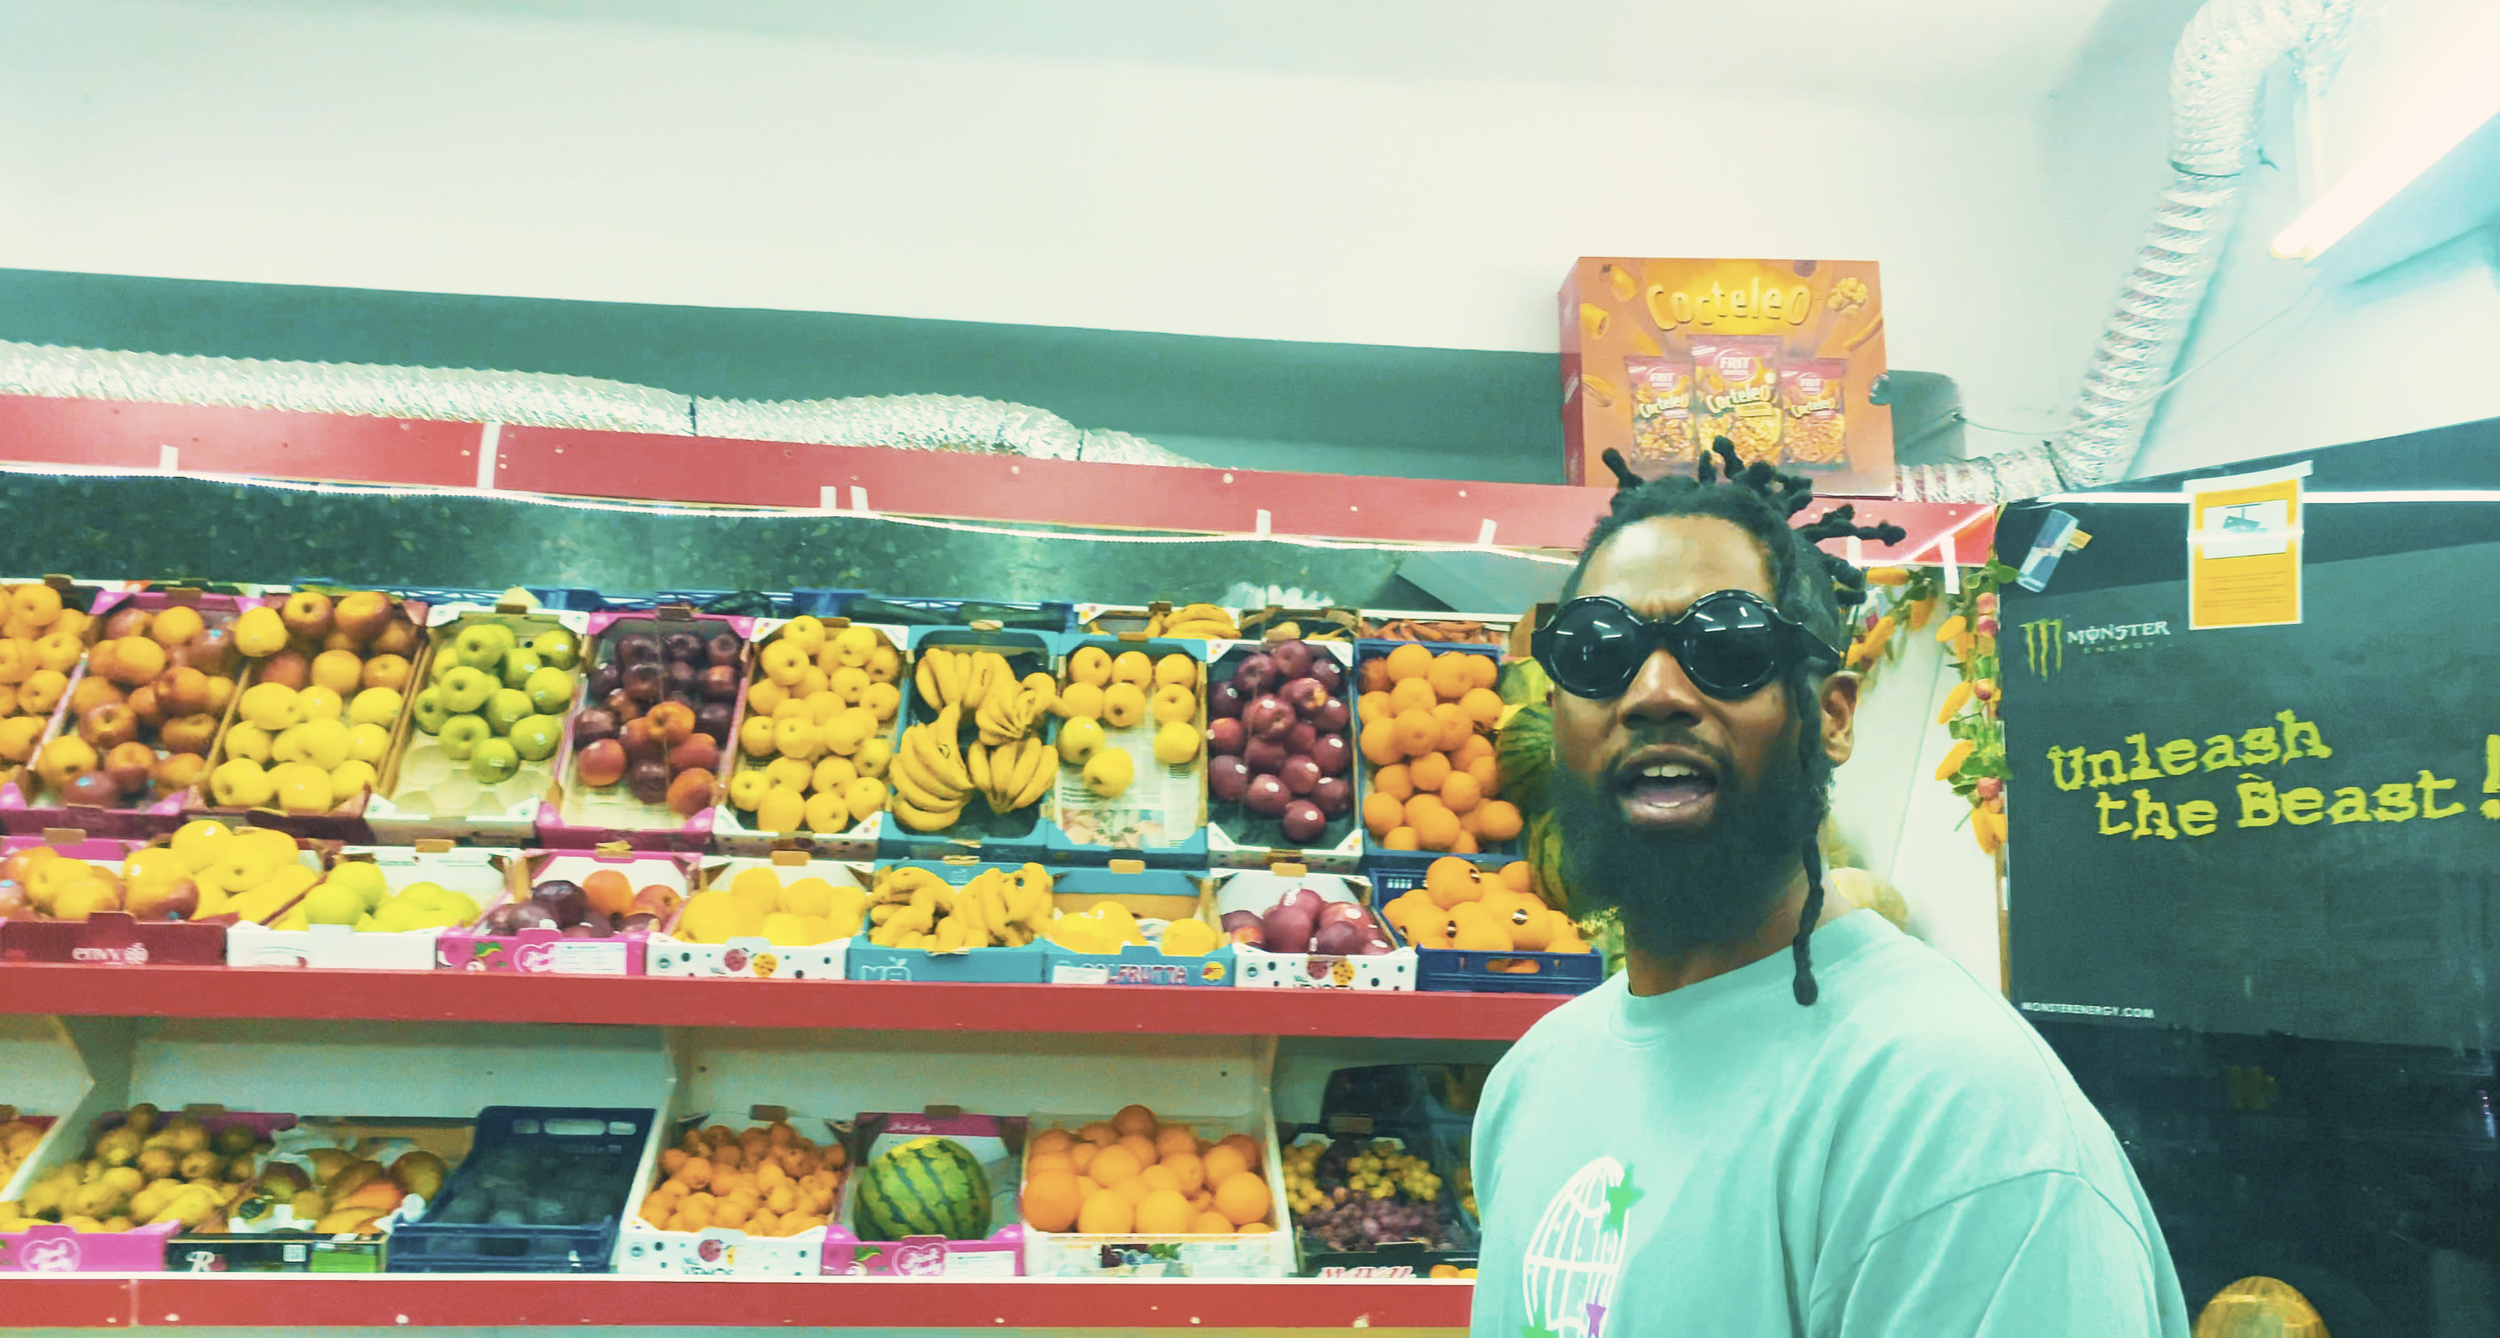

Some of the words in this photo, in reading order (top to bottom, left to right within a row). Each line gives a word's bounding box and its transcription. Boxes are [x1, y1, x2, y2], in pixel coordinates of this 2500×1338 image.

[1719, 356, 1752, 369] FRIT
[1649, 372, 1675, 382] FRIT
[2066, 620, 2171, 645] MONSTER
[2047, 709, 2333, 791] Unleash
[2096, 788, 2218, 840] the
[2021, 1002, 2154, 1018] MONSTERENERGY.COM
